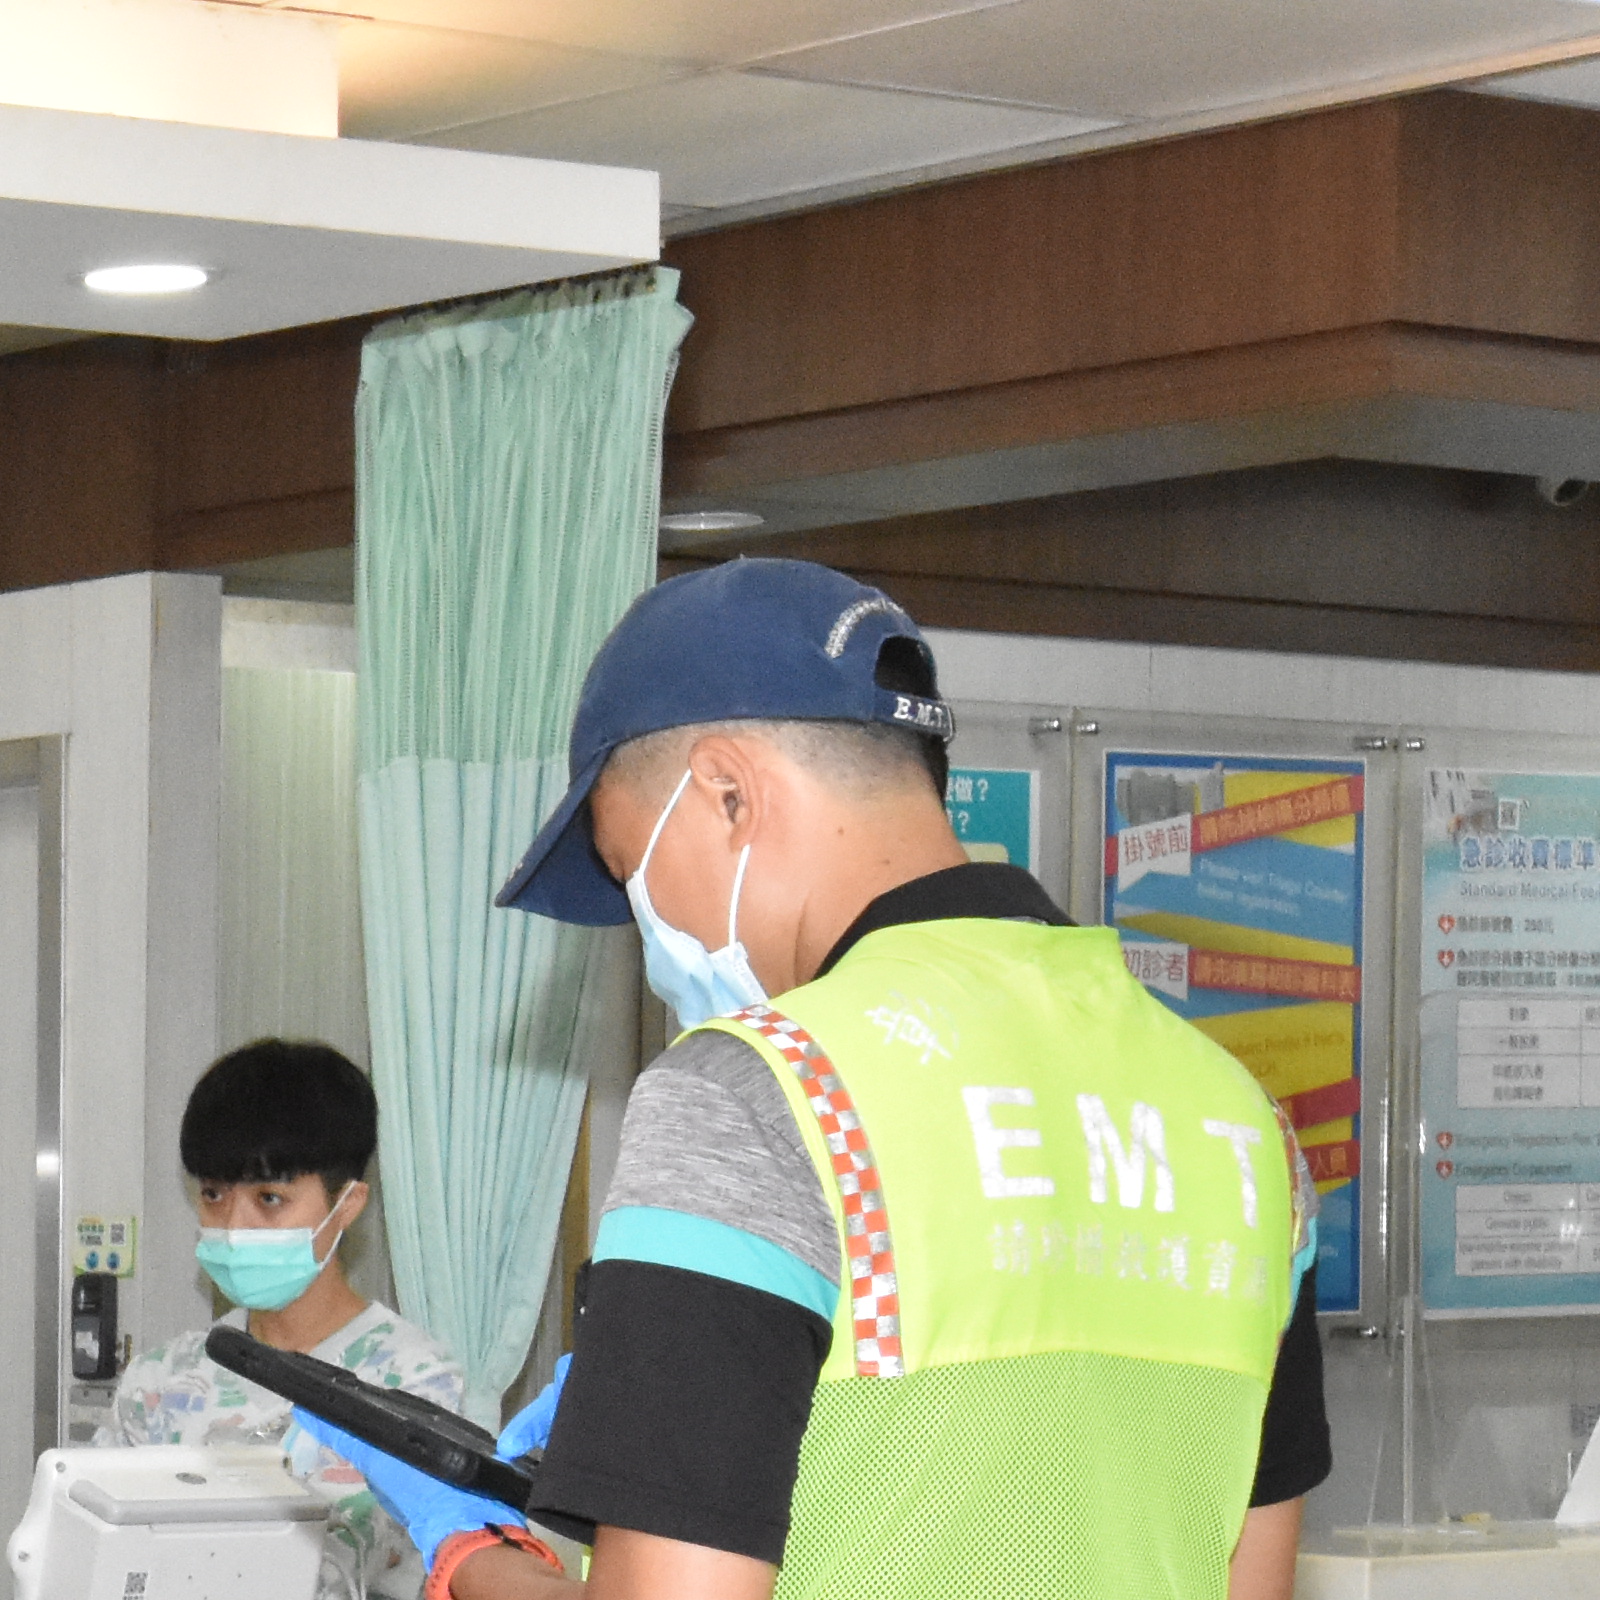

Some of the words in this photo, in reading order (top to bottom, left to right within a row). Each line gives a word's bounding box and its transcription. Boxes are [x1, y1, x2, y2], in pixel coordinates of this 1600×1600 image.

[1123, 823, 1189, 866] 掛號前
[1461, 836, 1595, 870] 急診收費標準
